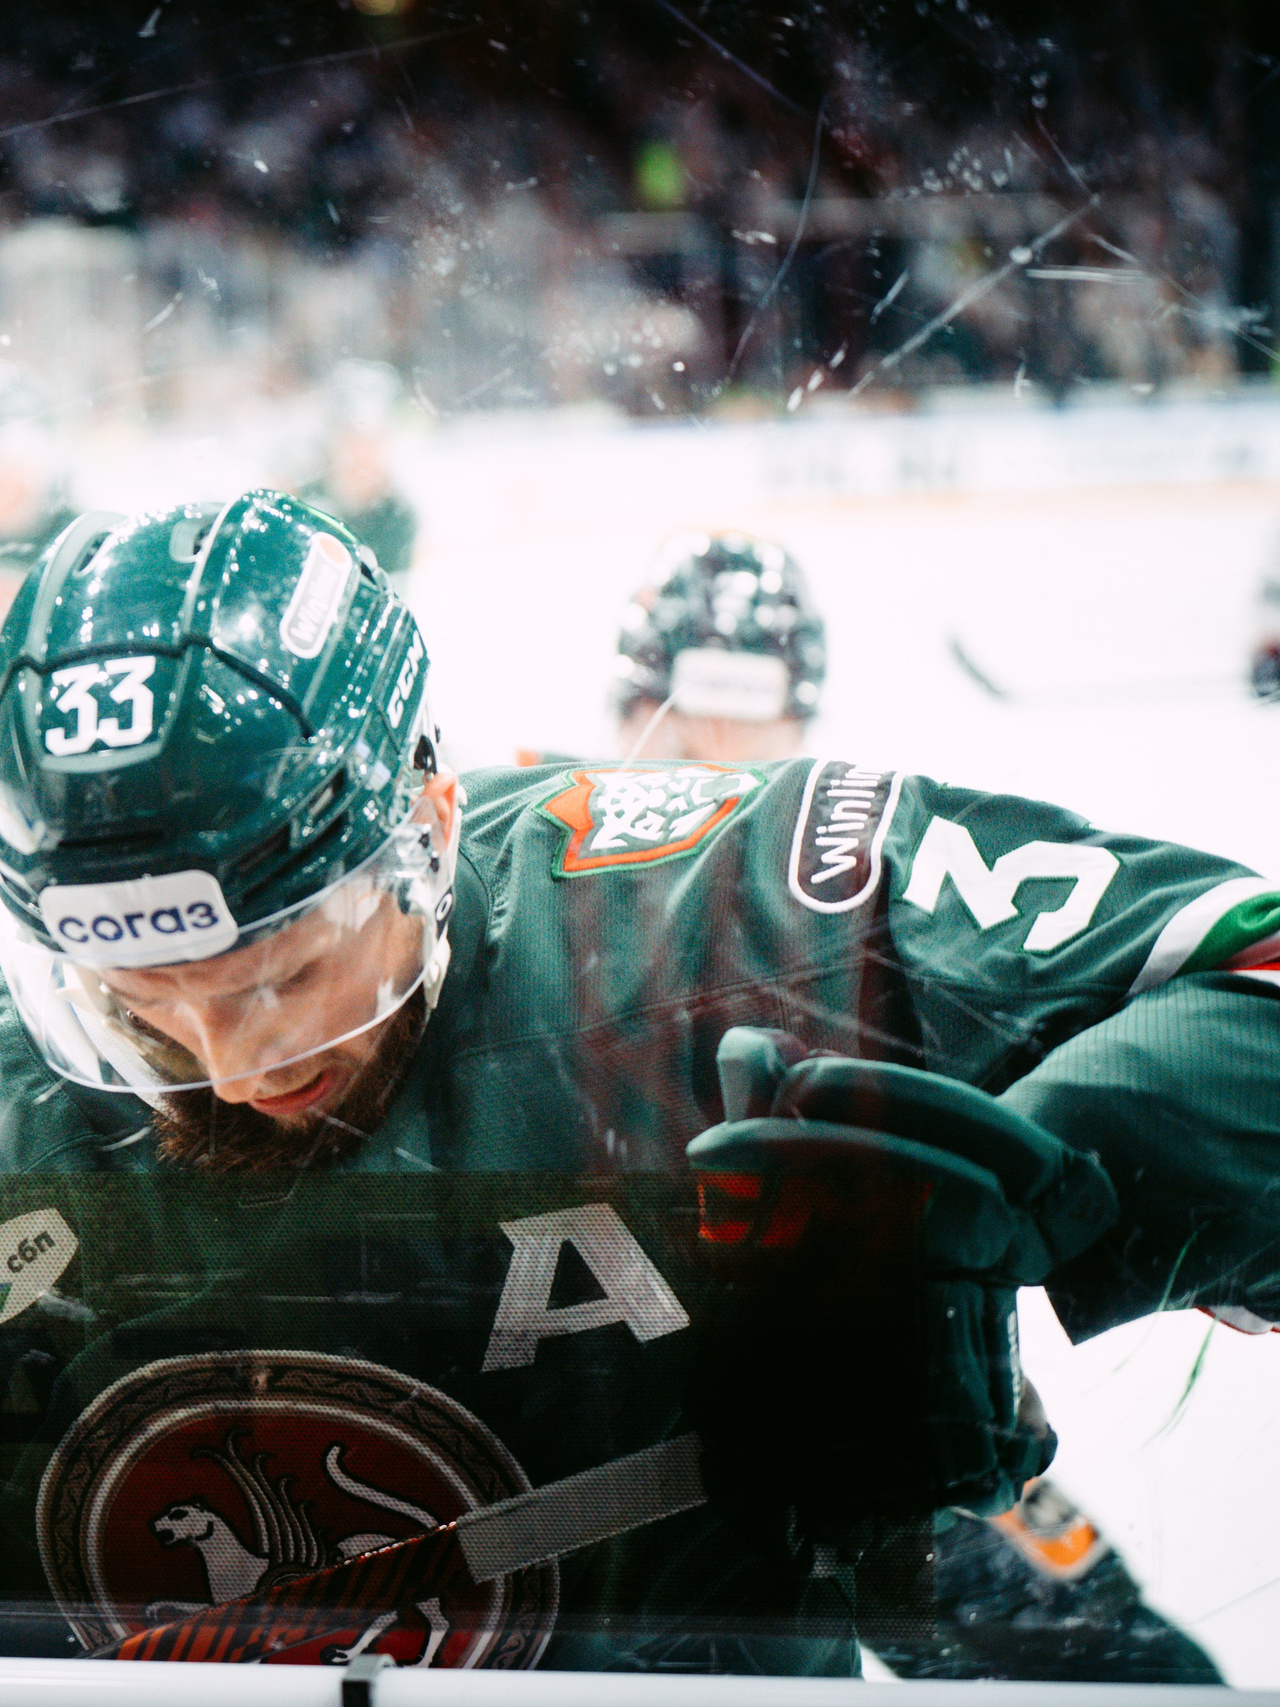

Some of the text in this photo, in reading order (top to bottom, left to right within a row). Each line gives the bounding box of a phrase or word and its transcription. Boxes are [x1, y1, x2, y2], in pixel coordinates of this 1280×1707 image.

[45, 655, 157, 757] 33
[386, 628, 424, 729] CCM
[58, 901, 219, 943] согаз
[902, 814, 1121, 951] 3
[6, 1230, 55, 1273] сбп
[480, 1203, 691, 1373] A
